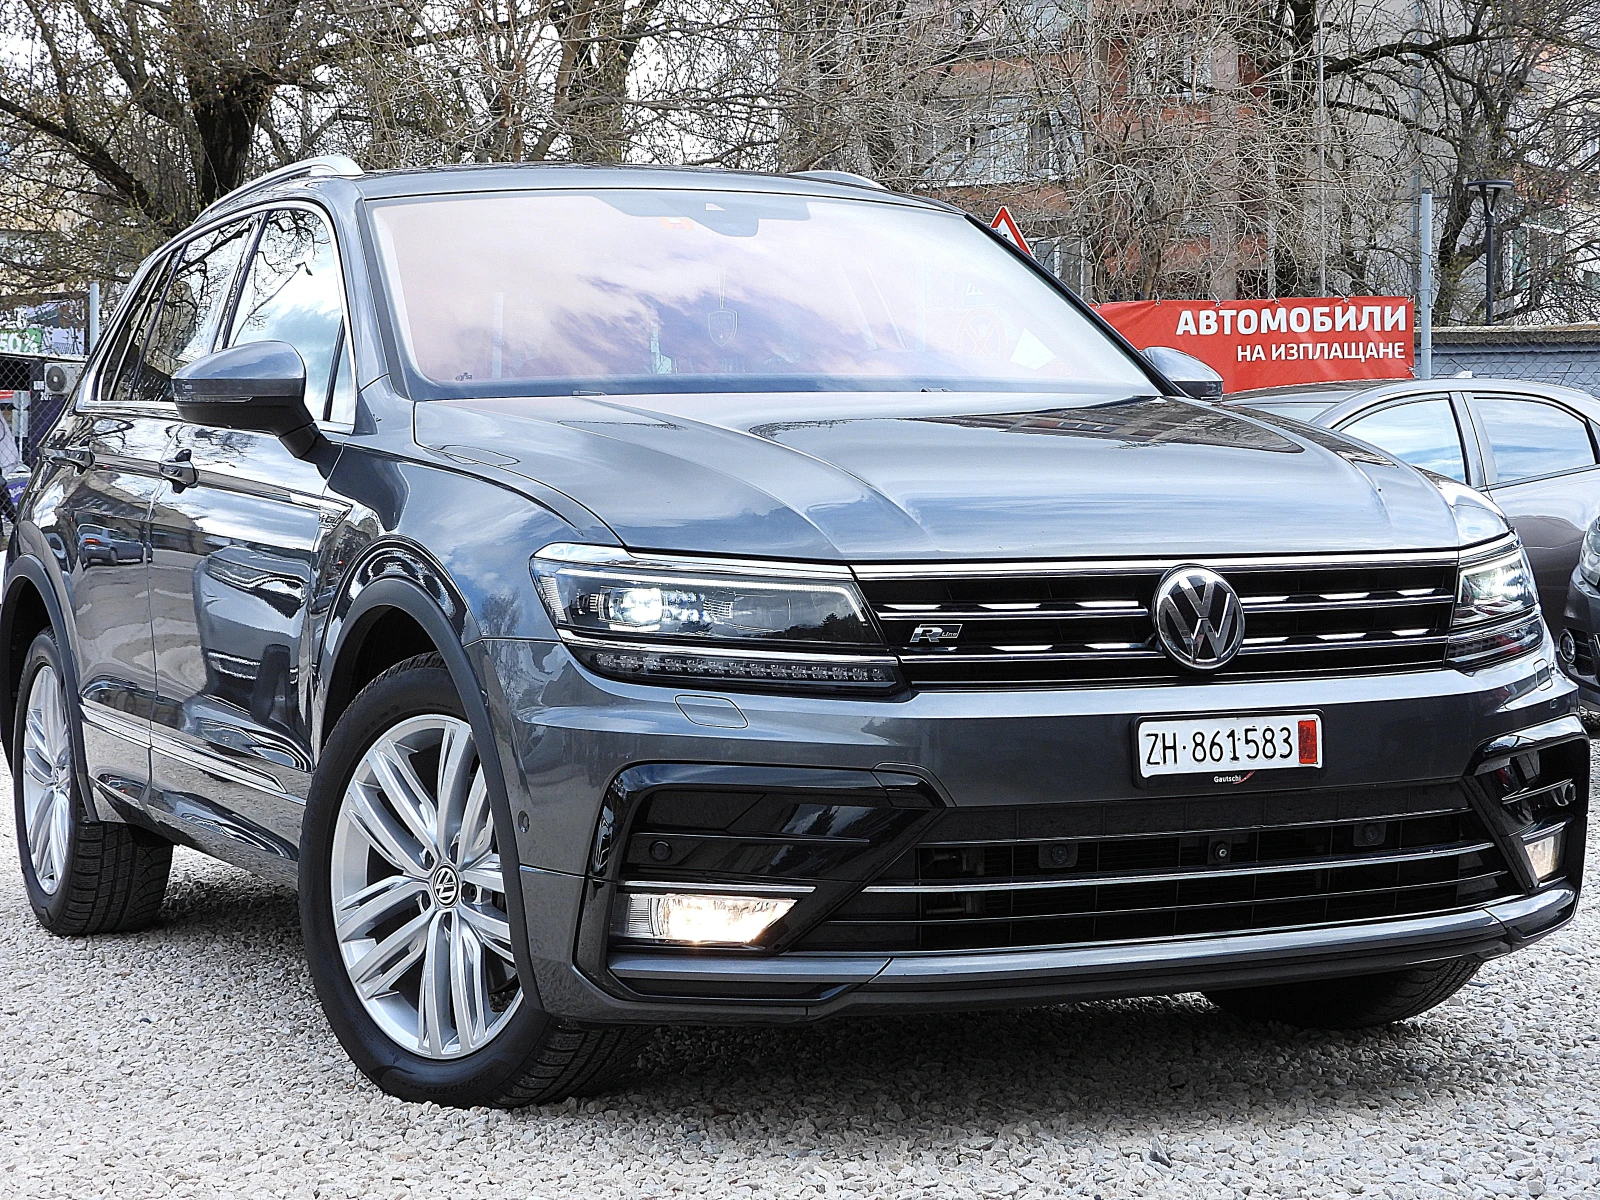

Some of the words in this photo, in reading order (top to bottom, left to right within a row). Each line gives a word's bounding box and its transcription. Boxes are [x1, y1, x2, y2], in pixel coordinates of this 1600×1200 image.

[1175, 305, 1407, 335] АВТОМОБИЛИ
[1236, 344, 1267, 362] НА
[1271, 342, 1406, 363] ИЗПЛАЩАНЕ
[1213, 774, 1242, 783] Gautschi
